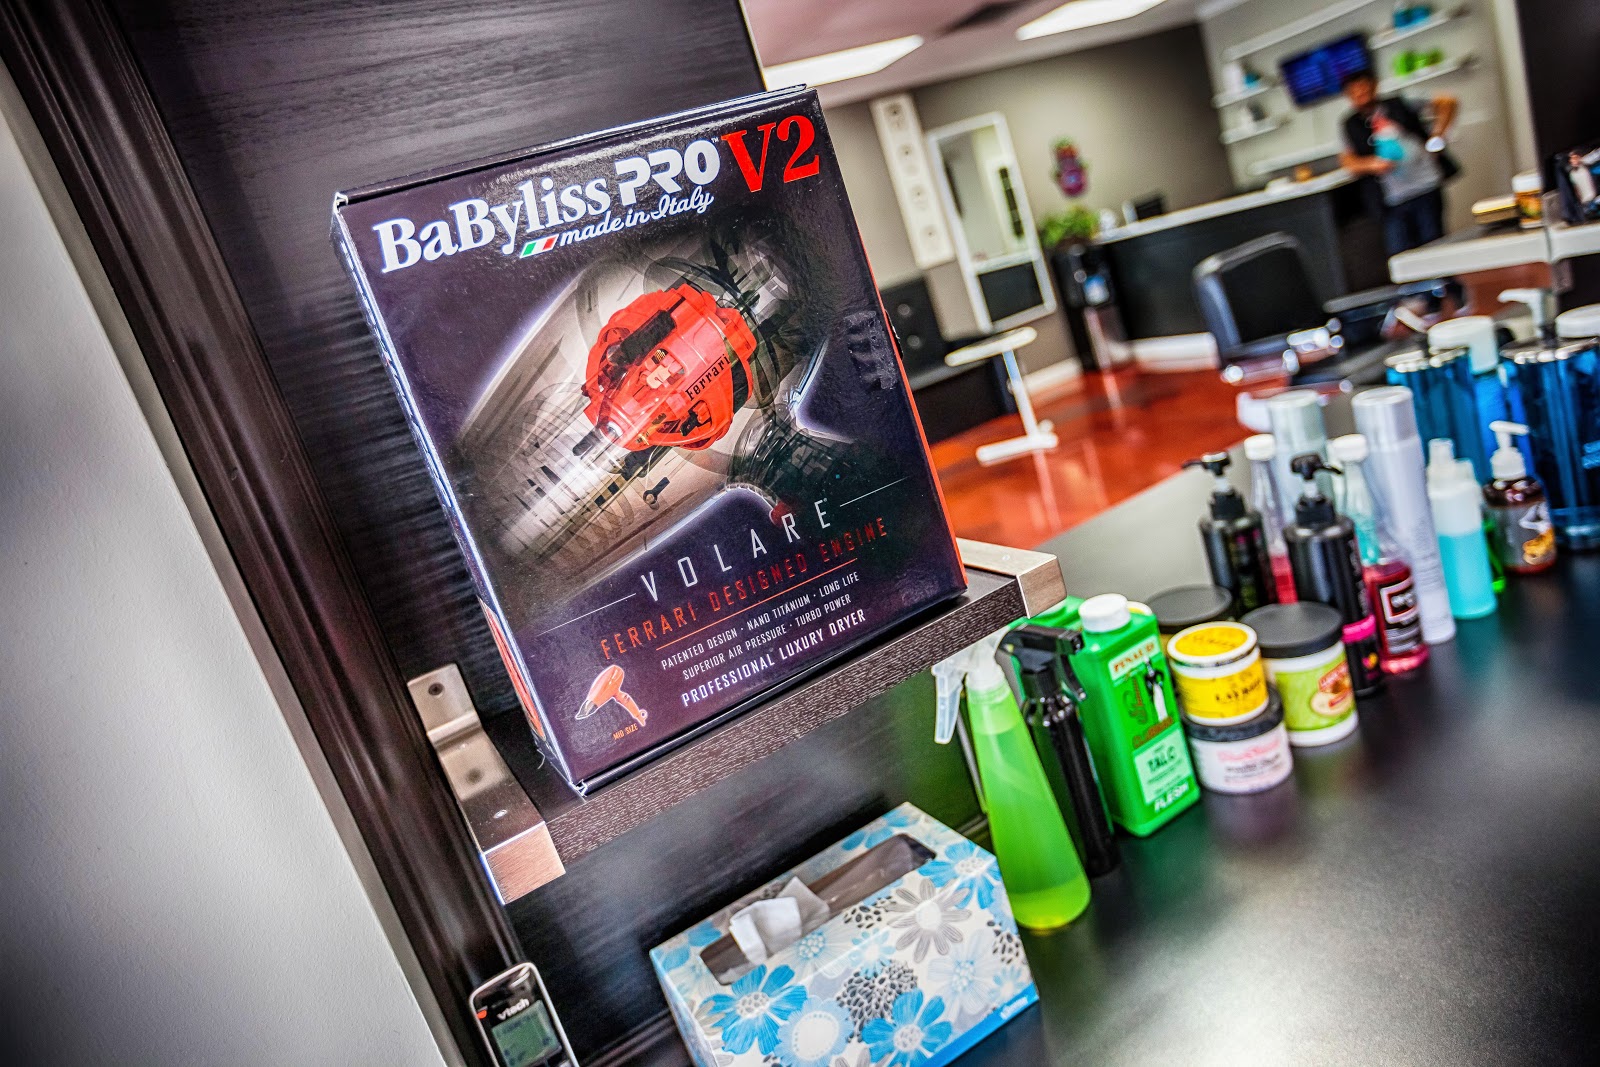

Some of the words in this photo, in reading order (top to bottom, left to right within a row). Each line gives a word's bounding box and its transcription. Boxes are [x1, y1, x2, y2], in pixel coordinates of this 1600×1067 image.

[720, 114, 820, 193] V2
[559, 210, 625, 247] made
[625, 208, 651, 228] in
[650, 185, 715, 220] Italy
[684, 353, 731, 401] Ferrari
[600, 601, 697, 660] FERRARI
[708, 553, 808, 612] DESIGNED
[819, 517, 887, 563] ENGINE
[640, 498, 831, 602] VOLARE
[661, 643, 705, 670] PATENTED
[706, 627, 738, 650] DESIGN
[746, 612, 771, 631] NANO
[771, 593, 811, 619] TITANIUM
[818, 580, 841, 598] LONG
[841, 571, 860, 587] LIFE
[681, 652, 776, 707] PROFESSIONAL
[778, 628, 824, 660] LUXURY
[828, 608, 866, 636] DRYER
[682, 653, 726, 681] SUPERIOR
[728, 644, 744, 660] AIR
[744, 623, 787, 651] PRESSURE
[794, 607, 822, 627] TURBO
[823, 593, 852, 613] POWER
[613, 729, 625, 741] MID
[624, 722, 639, 735] SIZE
